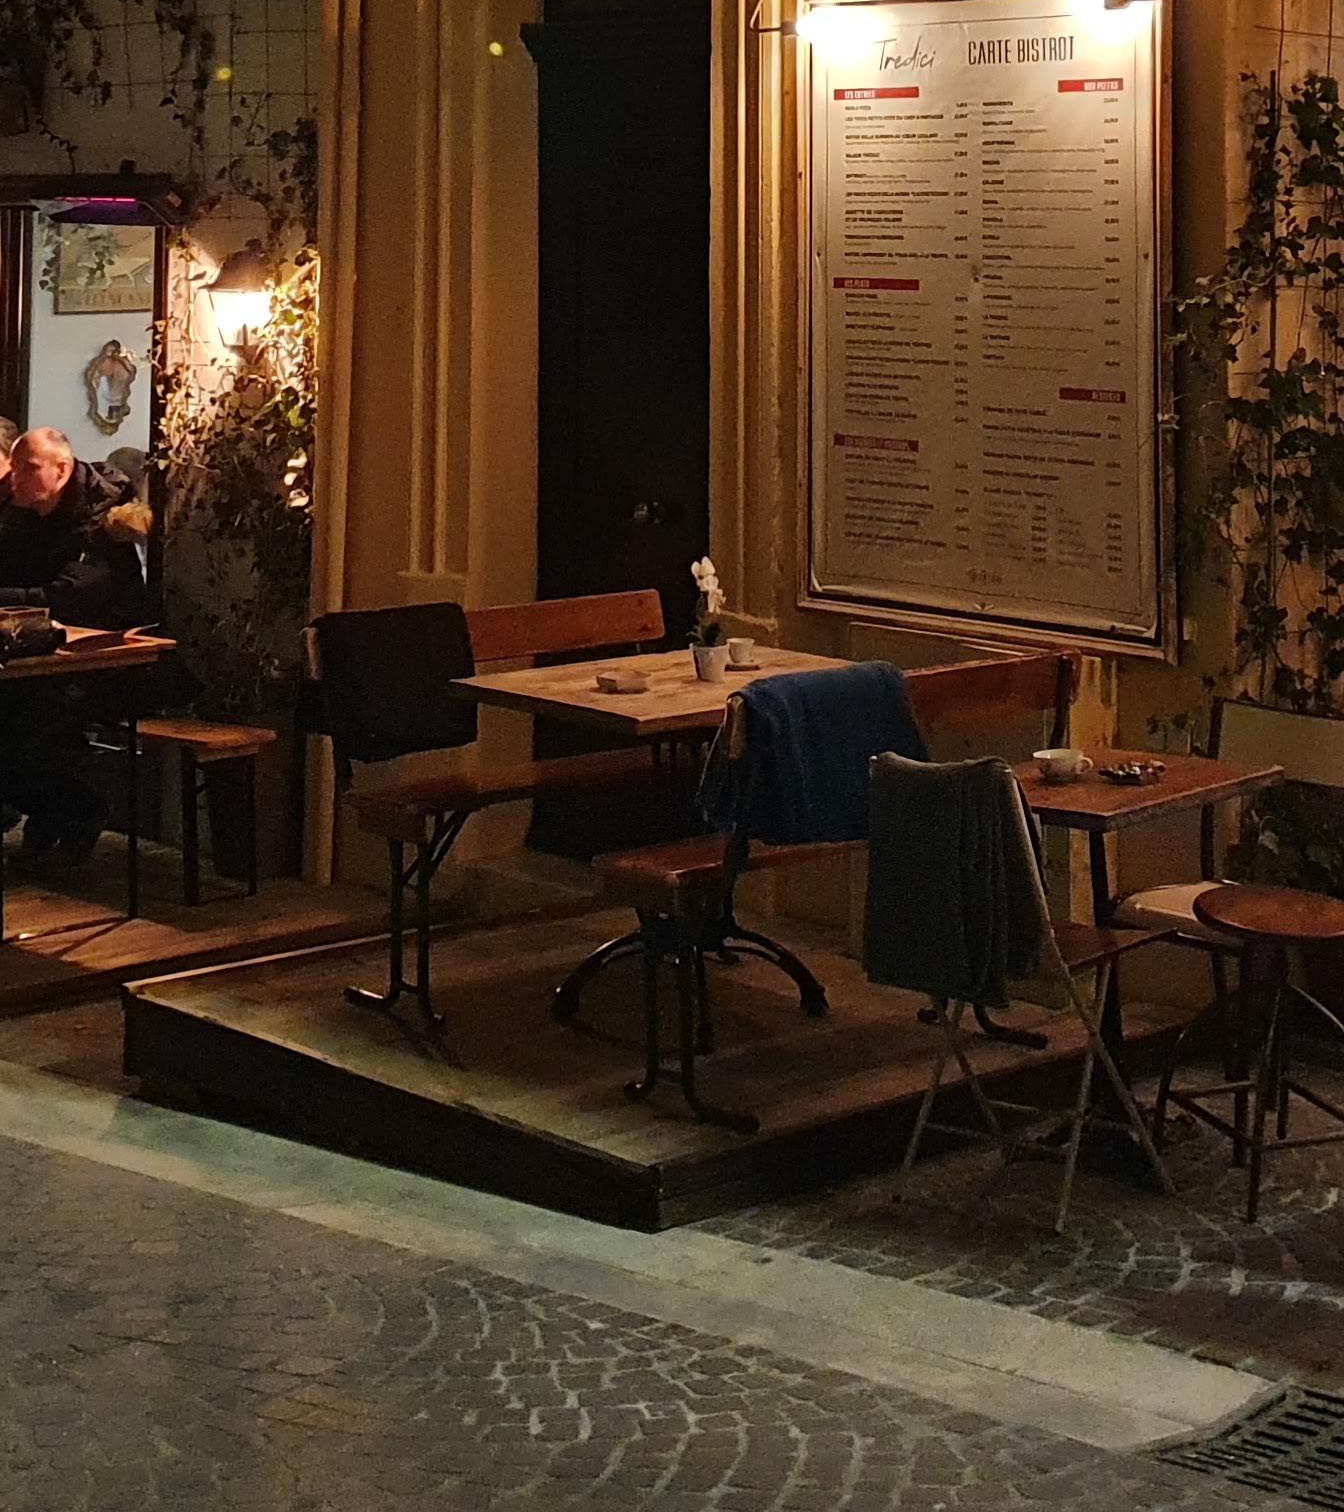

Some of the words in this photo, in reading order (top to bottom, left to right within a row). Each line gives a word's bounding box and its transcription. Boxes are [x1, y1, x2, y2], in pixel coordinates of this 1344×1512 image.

[873, 35, 936, 71] Tredici
[968, 39, 1012, 65] CARTE
[1017, 35, 1074, 63] BISTROT
